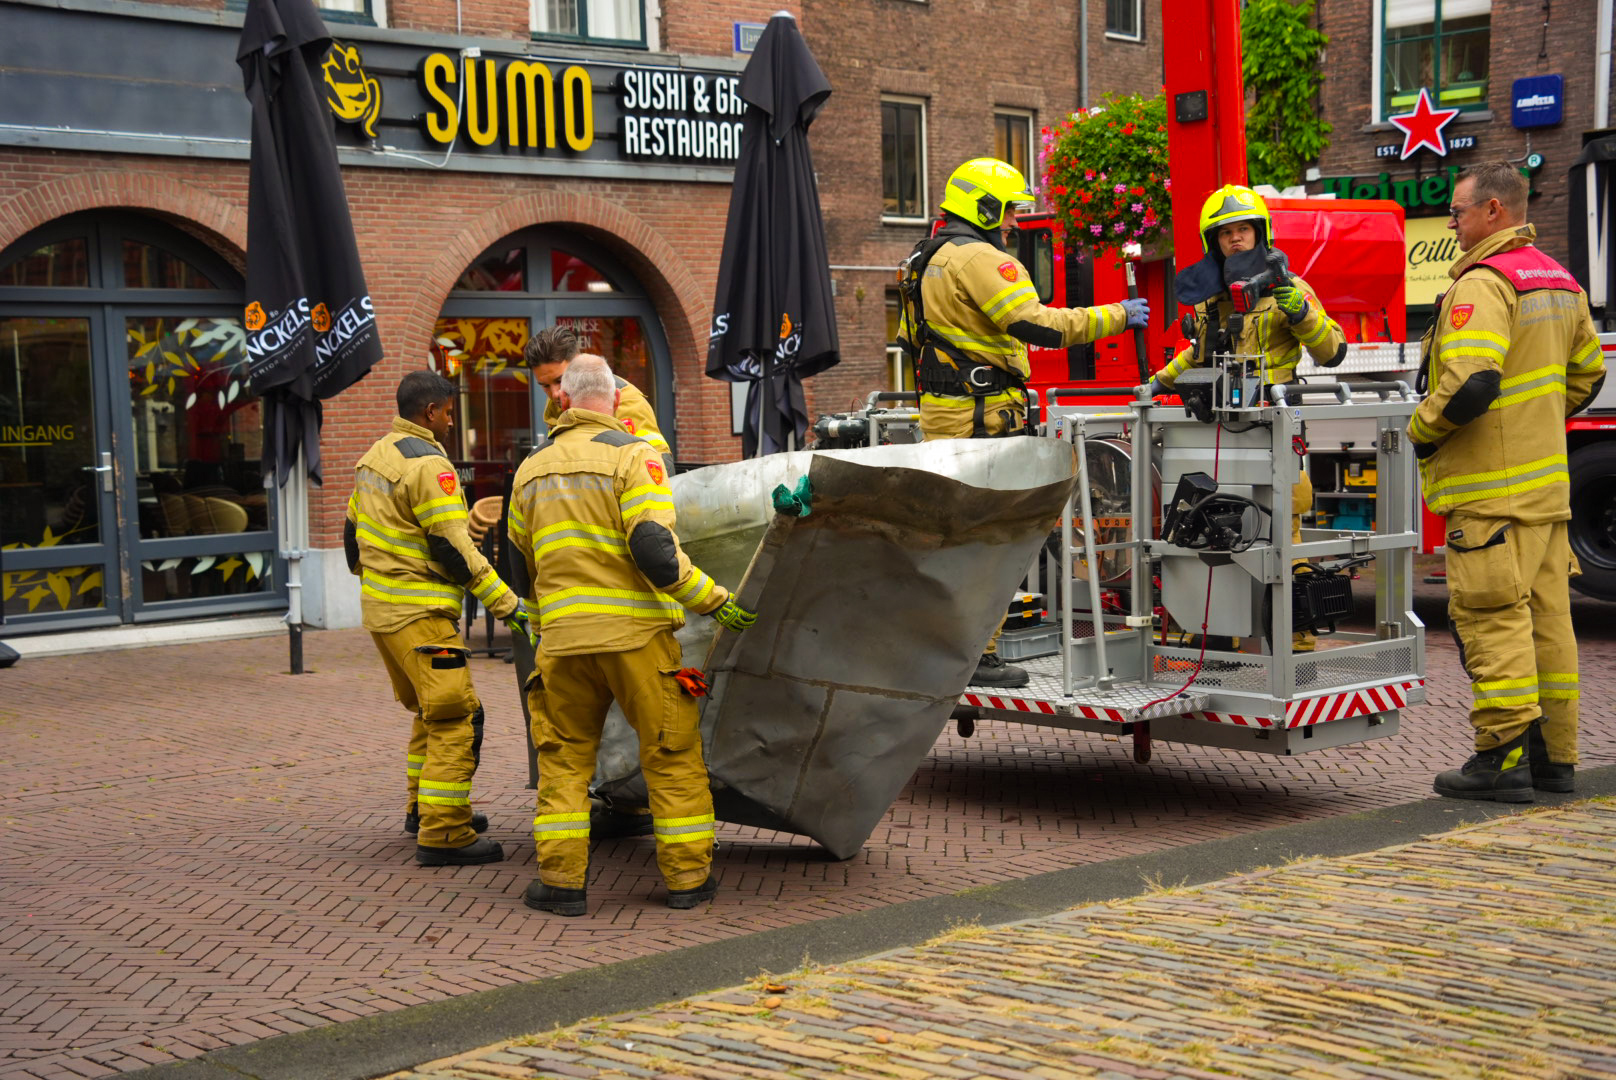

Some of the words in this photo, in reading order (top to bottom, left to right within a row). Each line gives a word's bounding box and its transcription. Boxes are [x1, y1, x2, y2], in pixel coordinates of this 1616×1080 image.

[424, 52, 594, 152] SUMO
[623, 70, 687, 111] SUSHI
[692, 75, 711, 113] &
[715, 77, 748, 115] GR
[1377, 146, 1399, 157] EST.
[1449, 137, 1474, 149] 1873
[2, 424, 75, 442] INGANG
